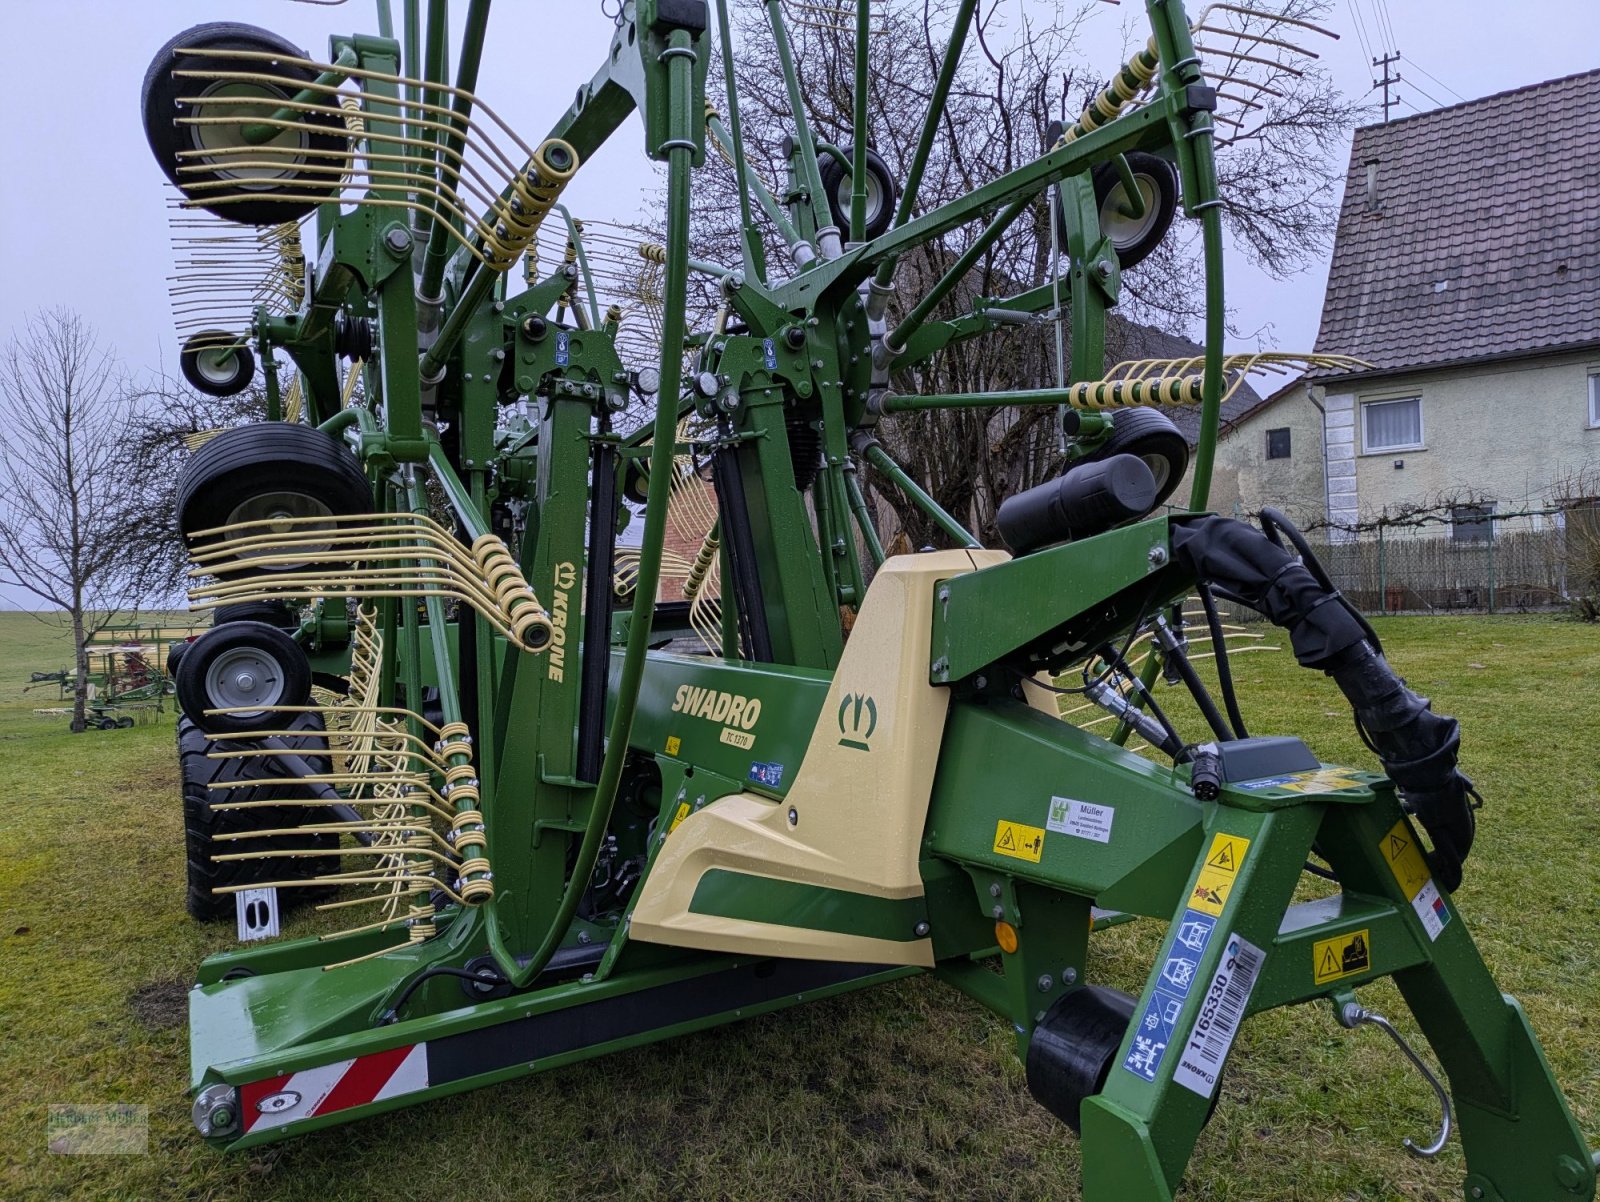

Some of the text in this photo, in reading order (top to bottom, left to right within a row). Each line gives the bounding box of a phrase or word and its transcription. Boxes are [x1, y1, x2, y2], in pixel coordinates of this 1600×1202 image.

[549, 590, 568, 683] KRONE
[671, 684, 762, 730] SWADRO
[725, 732, 748, 747] TC 1370
[1080, 804, 1104, 817] Müller
[1189, 974, 1228, 1050] 1165330
[1181, 1061, 1206, 1078] KRONE
